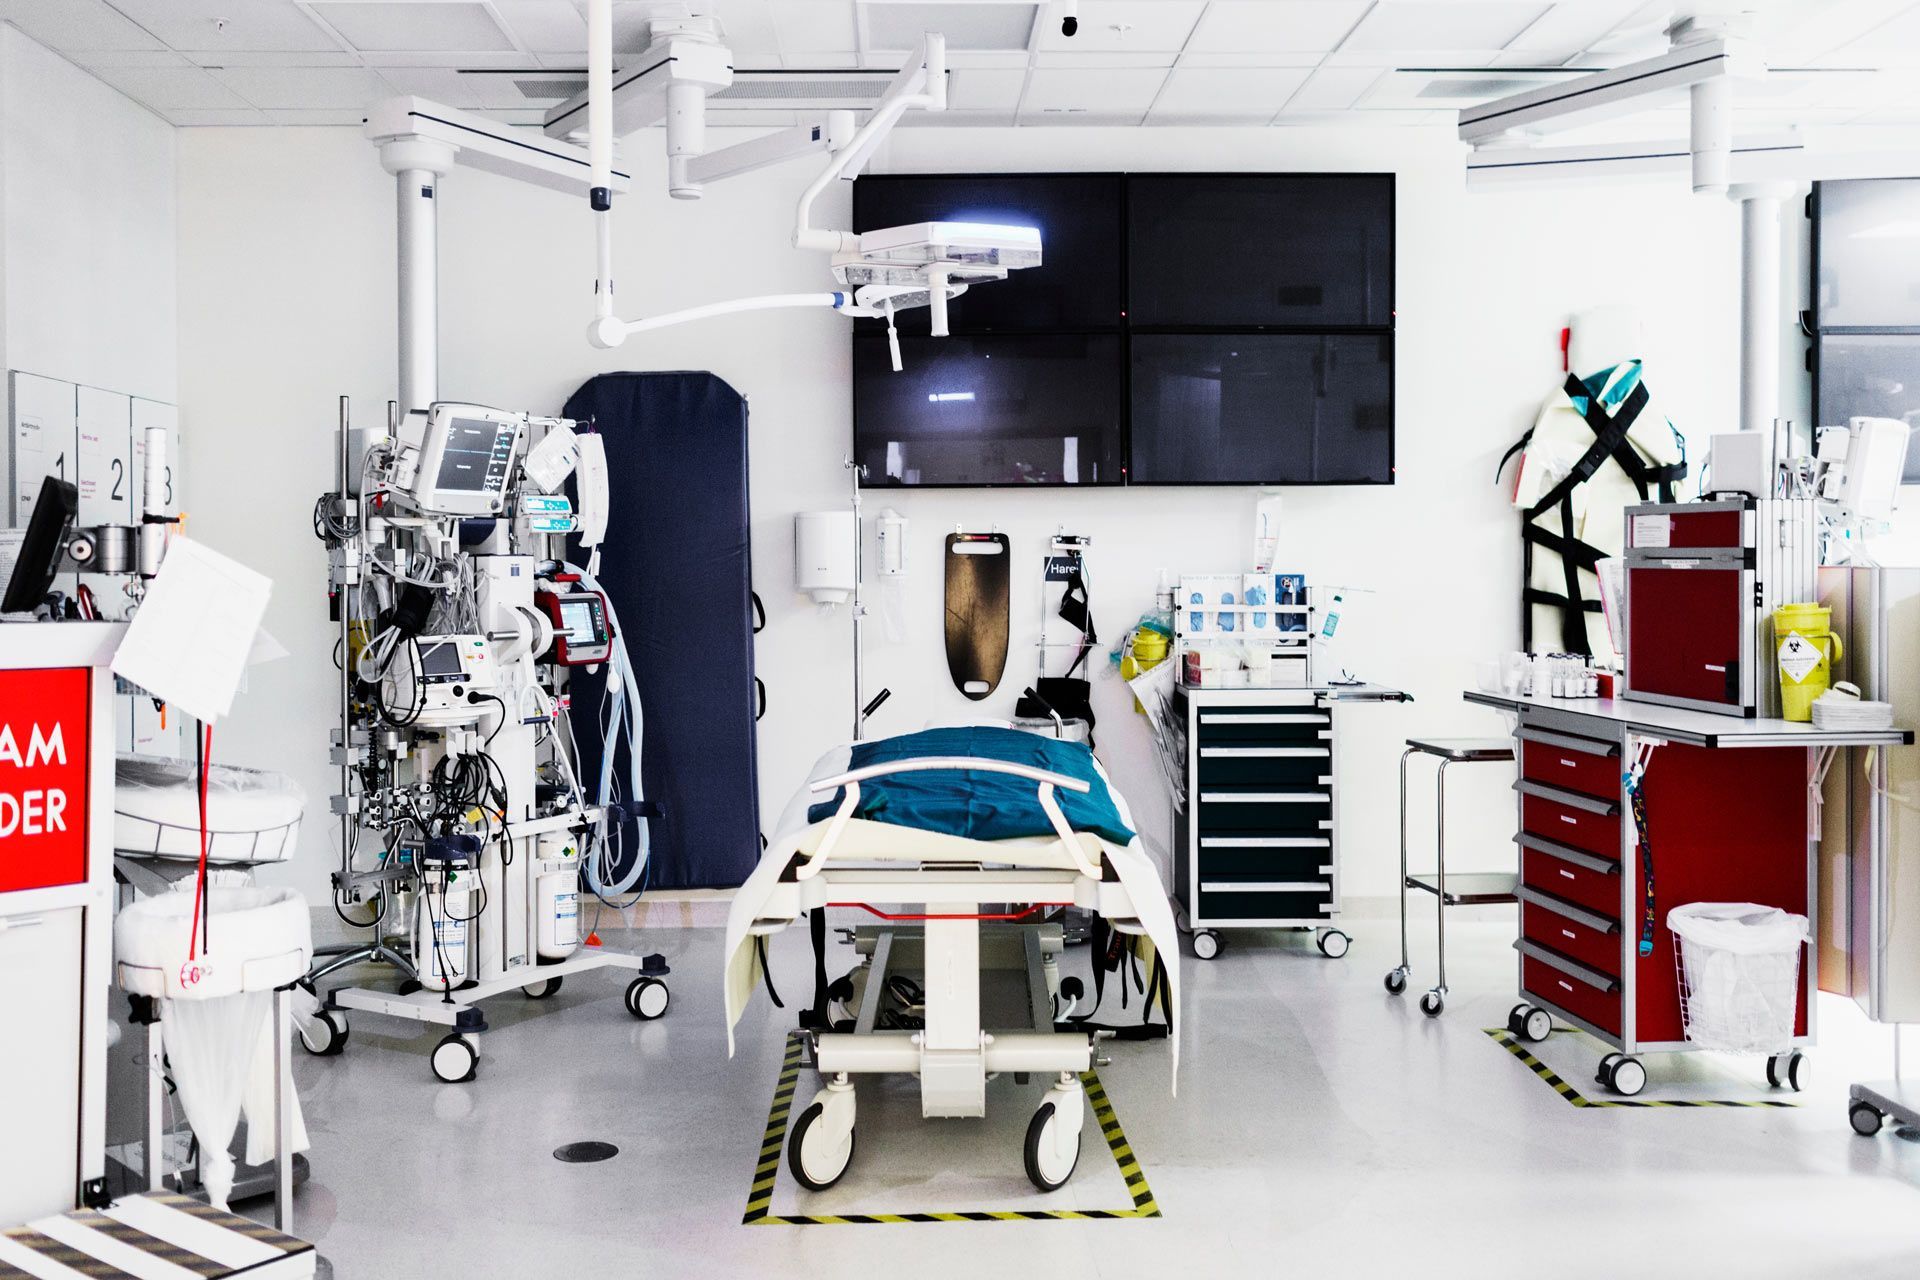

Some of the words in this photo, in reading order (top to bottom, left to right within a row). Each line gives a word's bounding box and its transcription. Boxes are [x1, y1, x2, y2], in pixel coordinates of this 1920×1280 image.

[56, 451, 64, 482] 1
[111, 458, 123, 501] 2
[165, 465, 172, 506] 3
[1050, 563, 1076, 574] Hare
[0, 720, 67, 768] AM
[0, 788, 67, 838] DER
